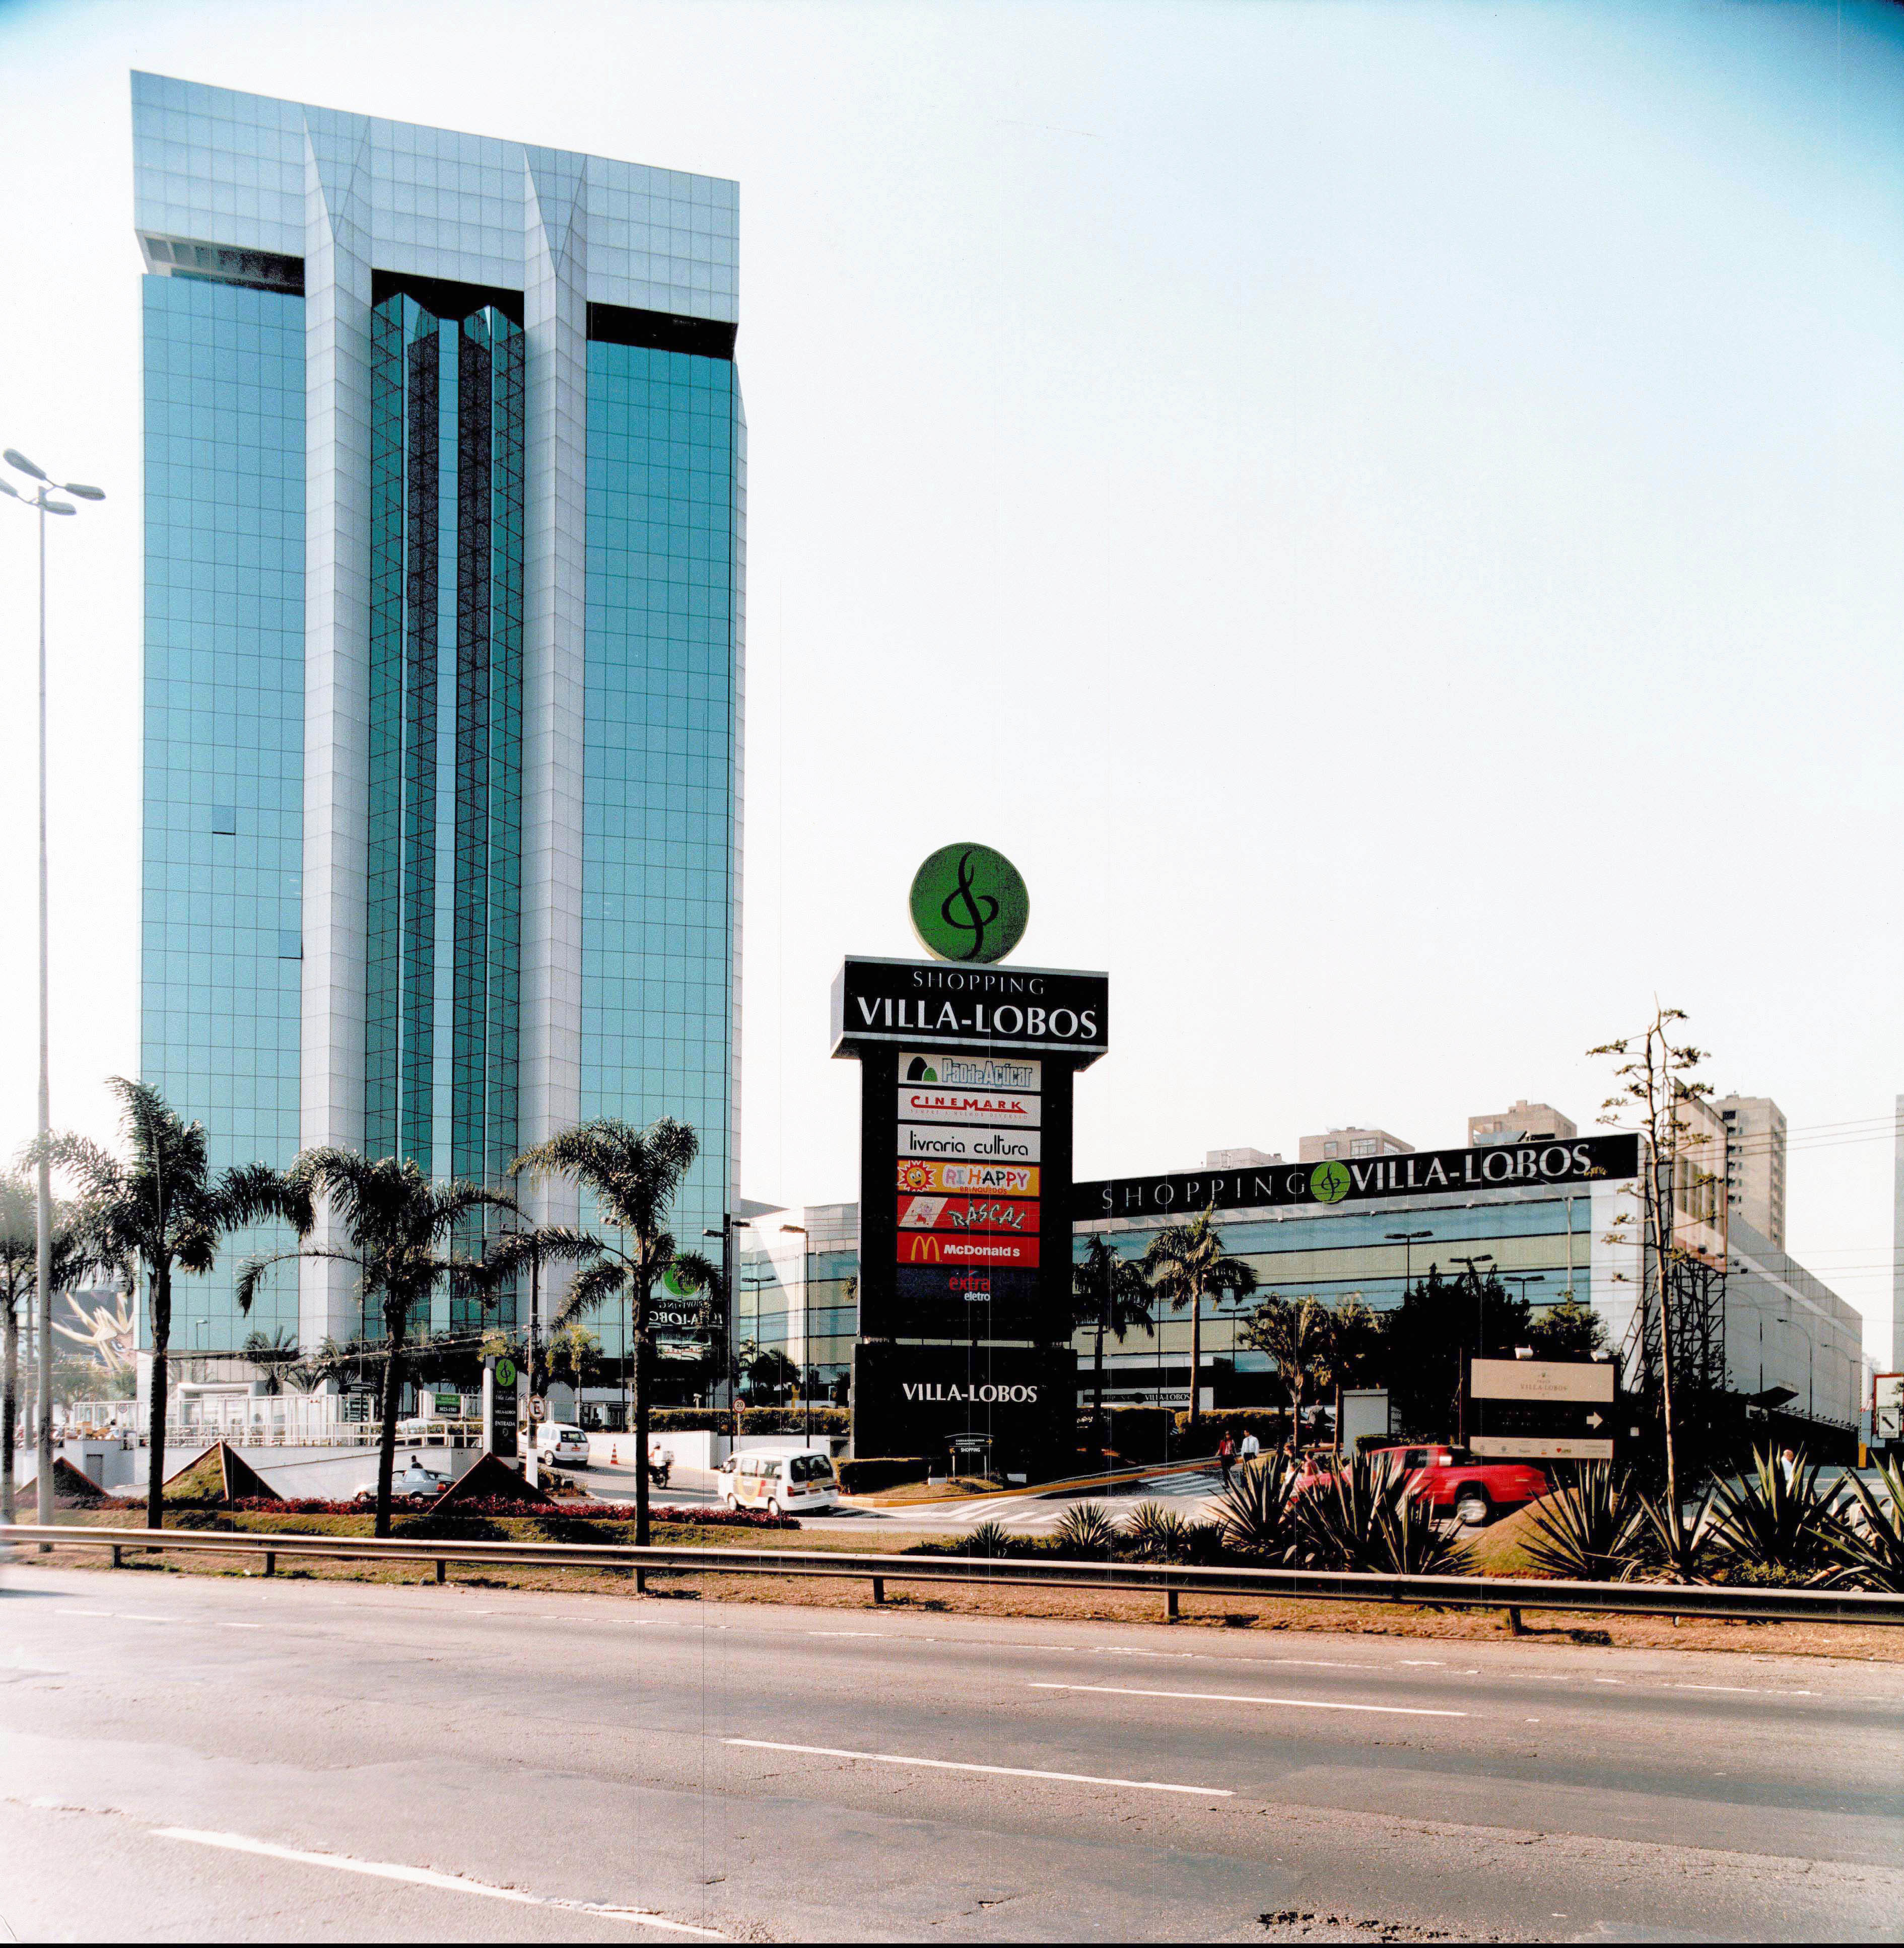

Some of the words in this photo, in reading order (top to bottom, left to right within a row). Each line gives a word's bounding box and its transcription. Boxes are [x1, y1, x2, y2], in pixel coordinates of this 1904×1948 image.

[913, 970, 1045, 995] SHOPPING
[857, 996, 1098, 1039] VILLA-LOBOS
[910, 1095, 1029, 1114] CINEMARK
[910, 1130, 965, 1153] livraria
[973, 1135, 1029, 1156] cultura
[945, 1168, 966, 1185] RI
[967, 1168, 1028, 1188] HAPPY
[1102, 1172, 1306, 1210] SHOPPING
[1350, 1143, 1592, 1192] VILLA-LOBOS
[960, 1186, 1007, 1195] BRINQUEDOS
[947, 1199, 1026, 1229] RASCAL
[949, 1275, 990, 1292] extra
[964, 1292, 990, 1301] eletro
[902, 1382, 1038, 1403] VILLA-LOBOS
